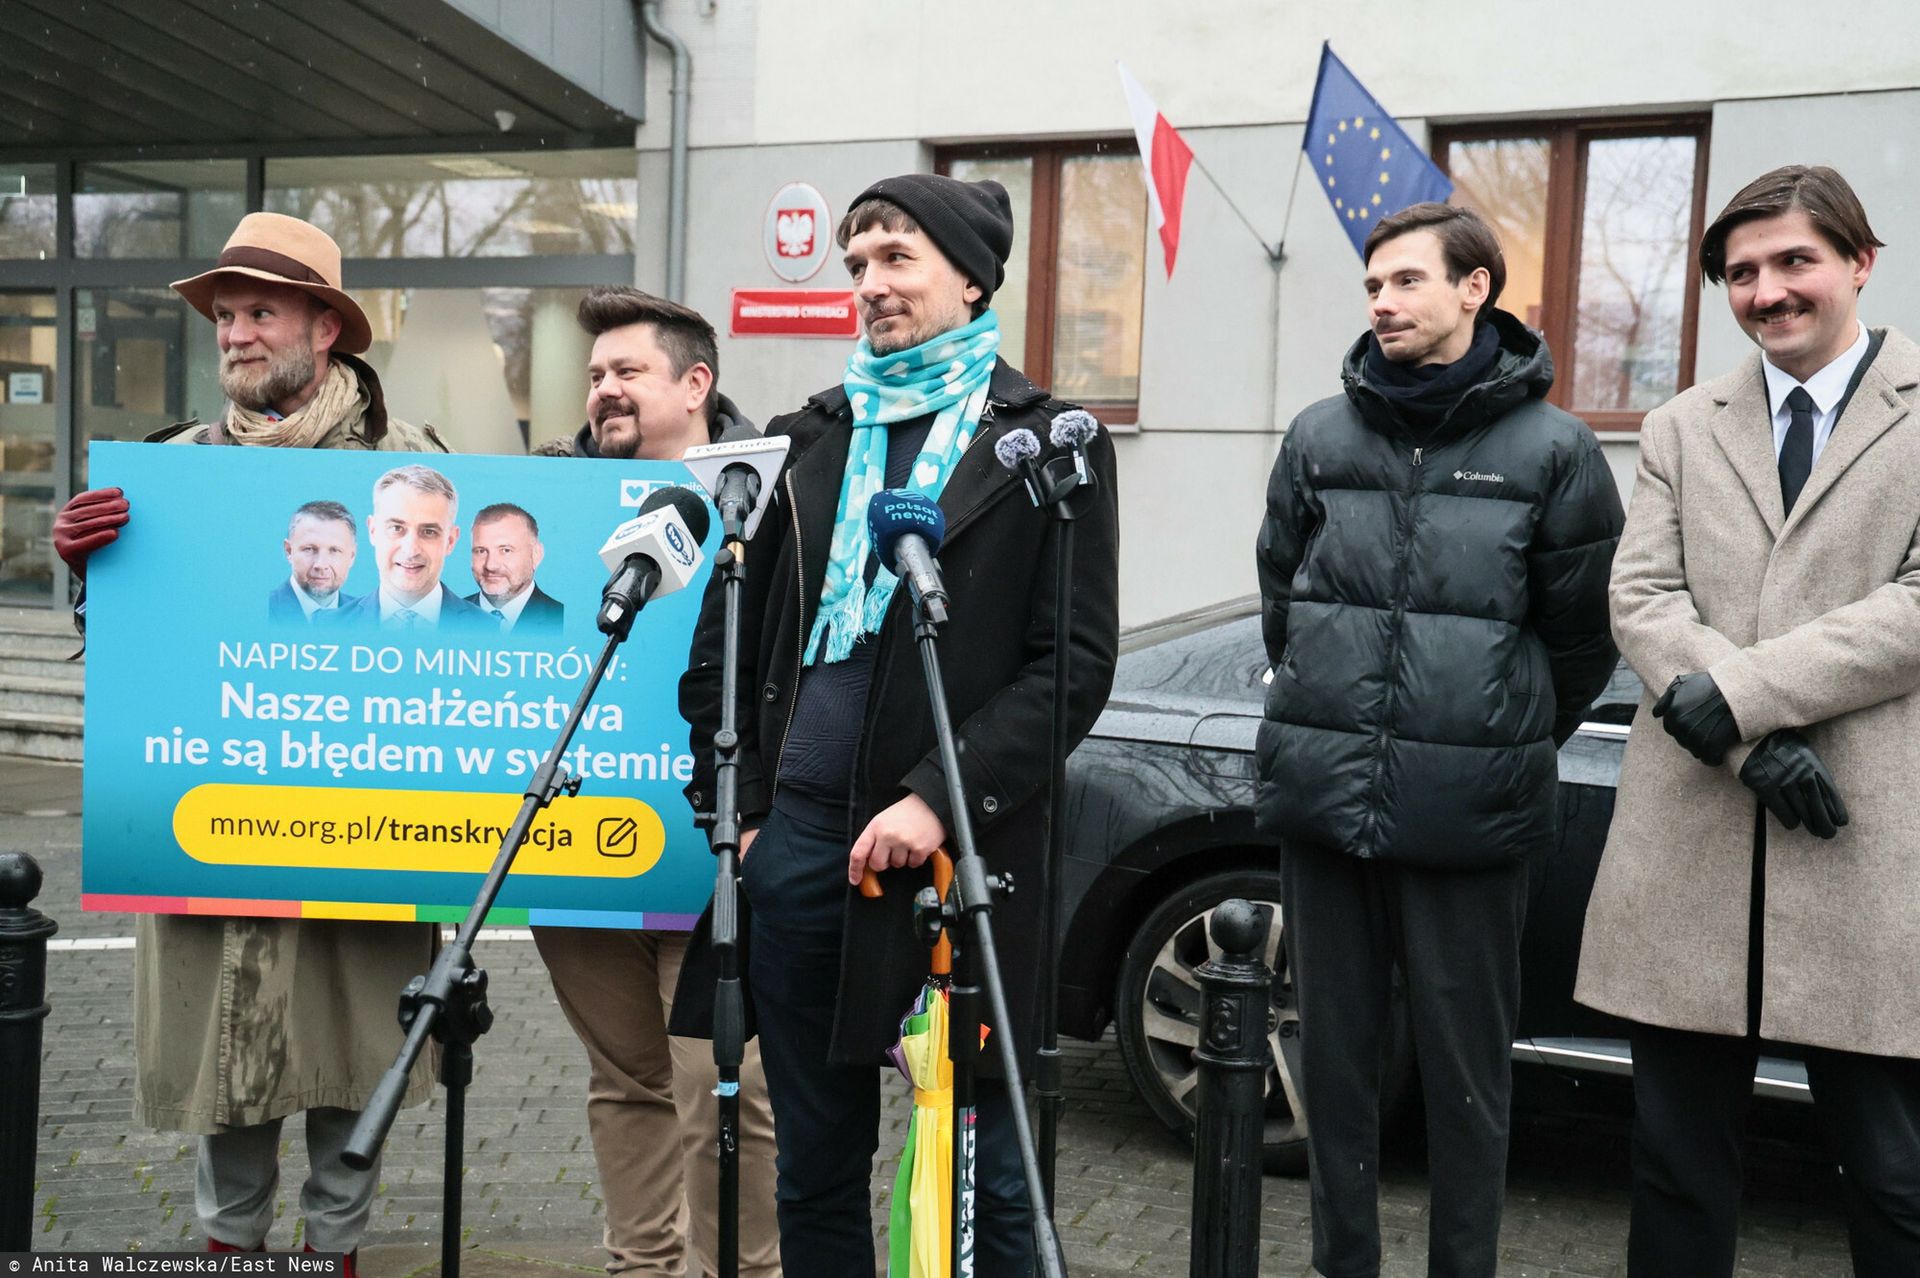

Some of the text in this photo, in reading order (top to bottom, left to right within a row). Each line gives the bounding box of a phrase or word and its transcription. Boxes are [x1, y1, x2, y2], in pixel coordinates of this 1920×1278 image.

[1463, 471, 1504, 483] Columbia
[884, 502, 939, 519] polsat
[891, 511, 935, 525] news
[219, 641, 627, 681] NAPISZ DO MINISTRÓW:
[221, 681, 623, 731] Nasze małżeństwa
[145, 726, 210, 765] nie
[222, 739, 268, 776] są
[281, 730, 443, 778] błędem
[456, 747, 495, 775] w
